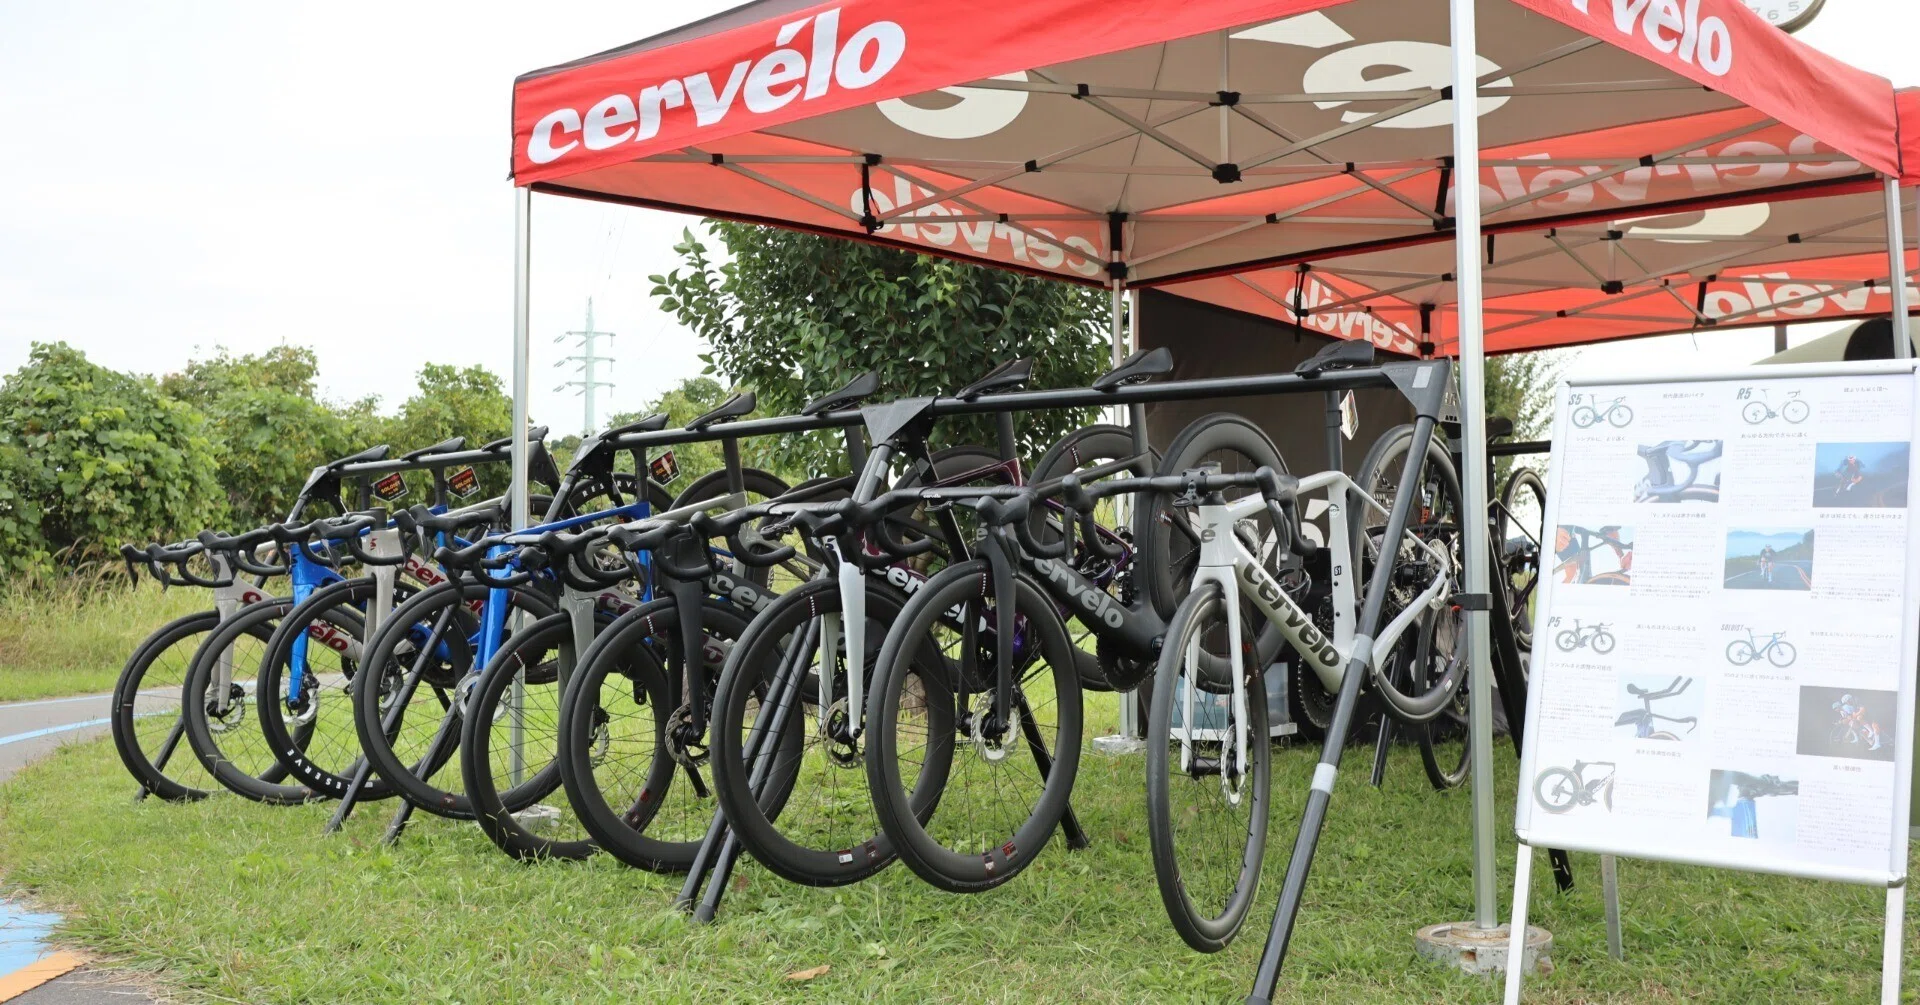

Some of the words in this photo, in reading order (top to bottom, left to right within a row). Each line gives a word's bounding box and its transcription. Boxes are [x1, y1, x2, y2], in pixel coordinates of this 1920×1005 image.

[527, 7, 906, 164] cervélo
[1568, 393, 1583, 406] S5
[1736, 387, 1753, 400] R5
[1547, 616, 1562, 628] P5
[1720, 623, 1745, 632] SOLOIST
